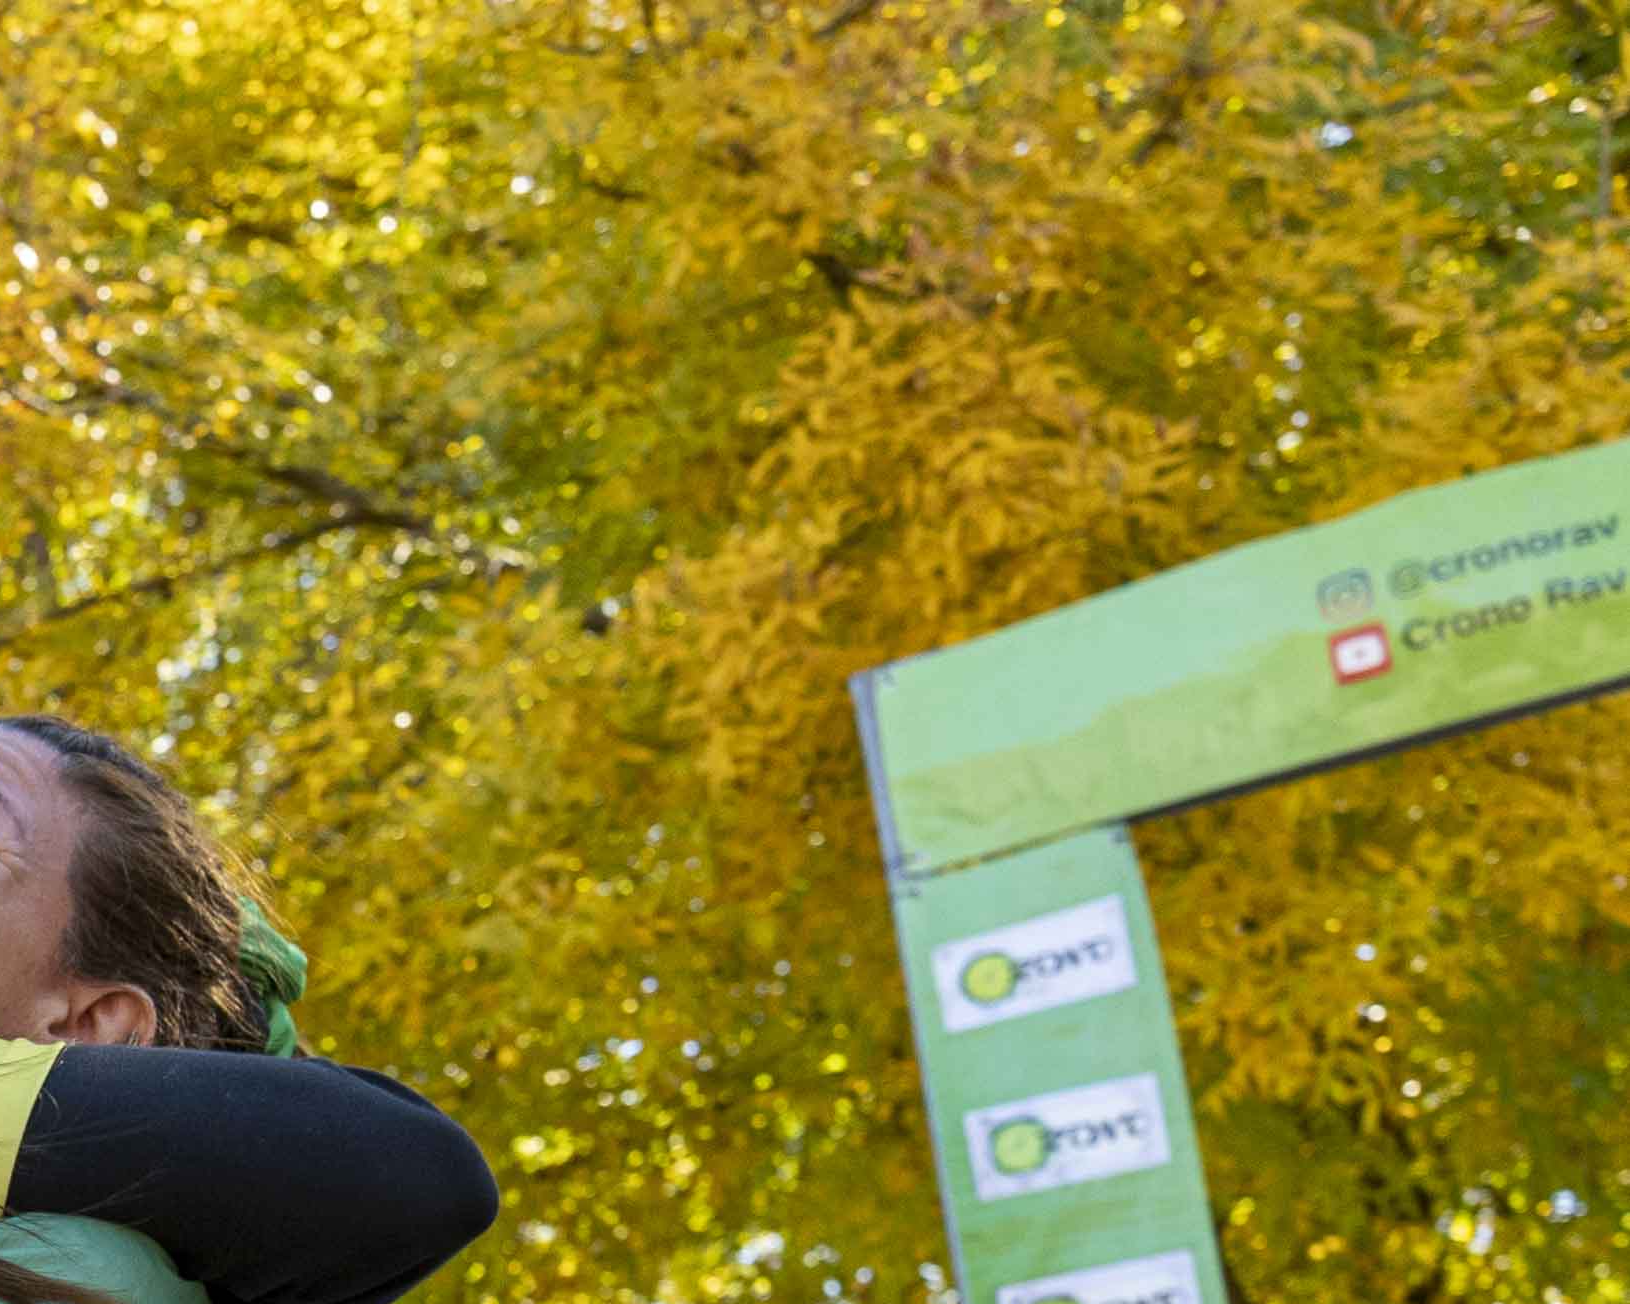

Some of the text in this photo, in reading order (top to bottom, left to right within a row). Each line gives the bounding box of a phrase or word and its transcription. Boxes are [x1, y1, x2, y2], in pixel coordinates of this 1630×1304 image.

[1388, 513, 1620, 597] @cronorav
[1401, 567, 1627, 651] Crono Rav
